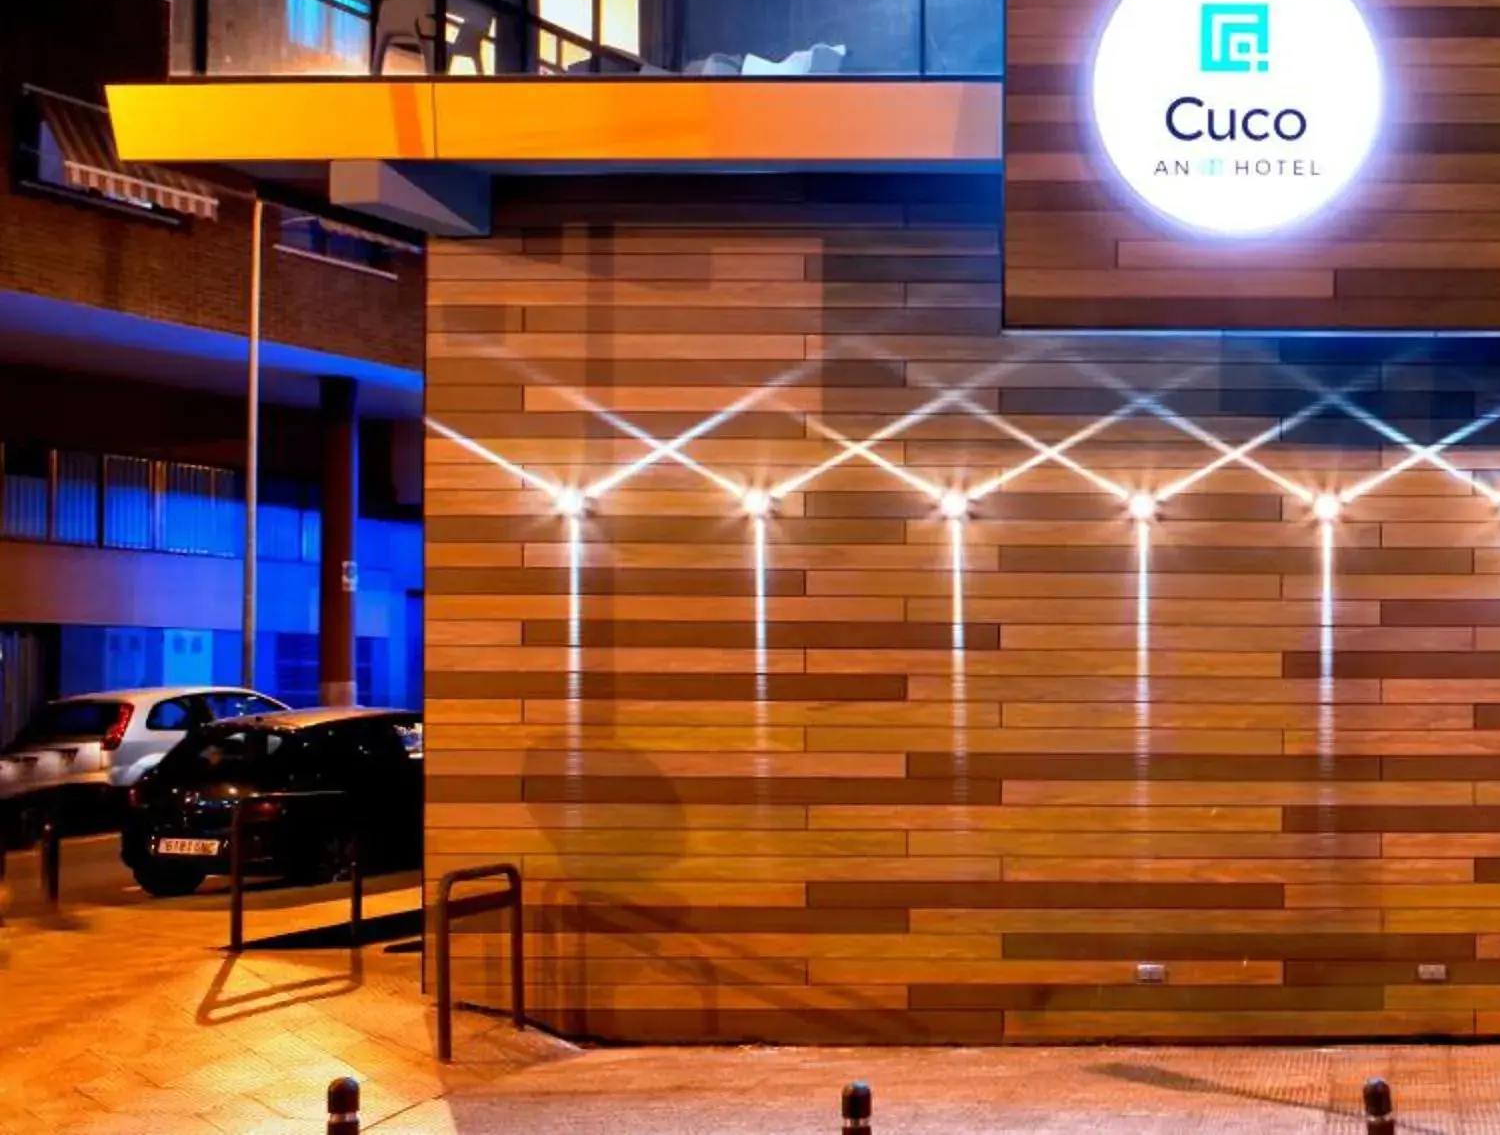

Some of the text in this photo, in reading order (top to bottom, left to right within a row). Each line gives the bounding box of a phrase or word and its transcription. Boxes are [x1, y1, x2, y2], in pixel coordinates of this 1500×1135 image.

[1165, 96, 1307, 141] Cuco
[1154, 160, 1190, 176] AN
[1235, 159, 1321, 176] HOTEL
